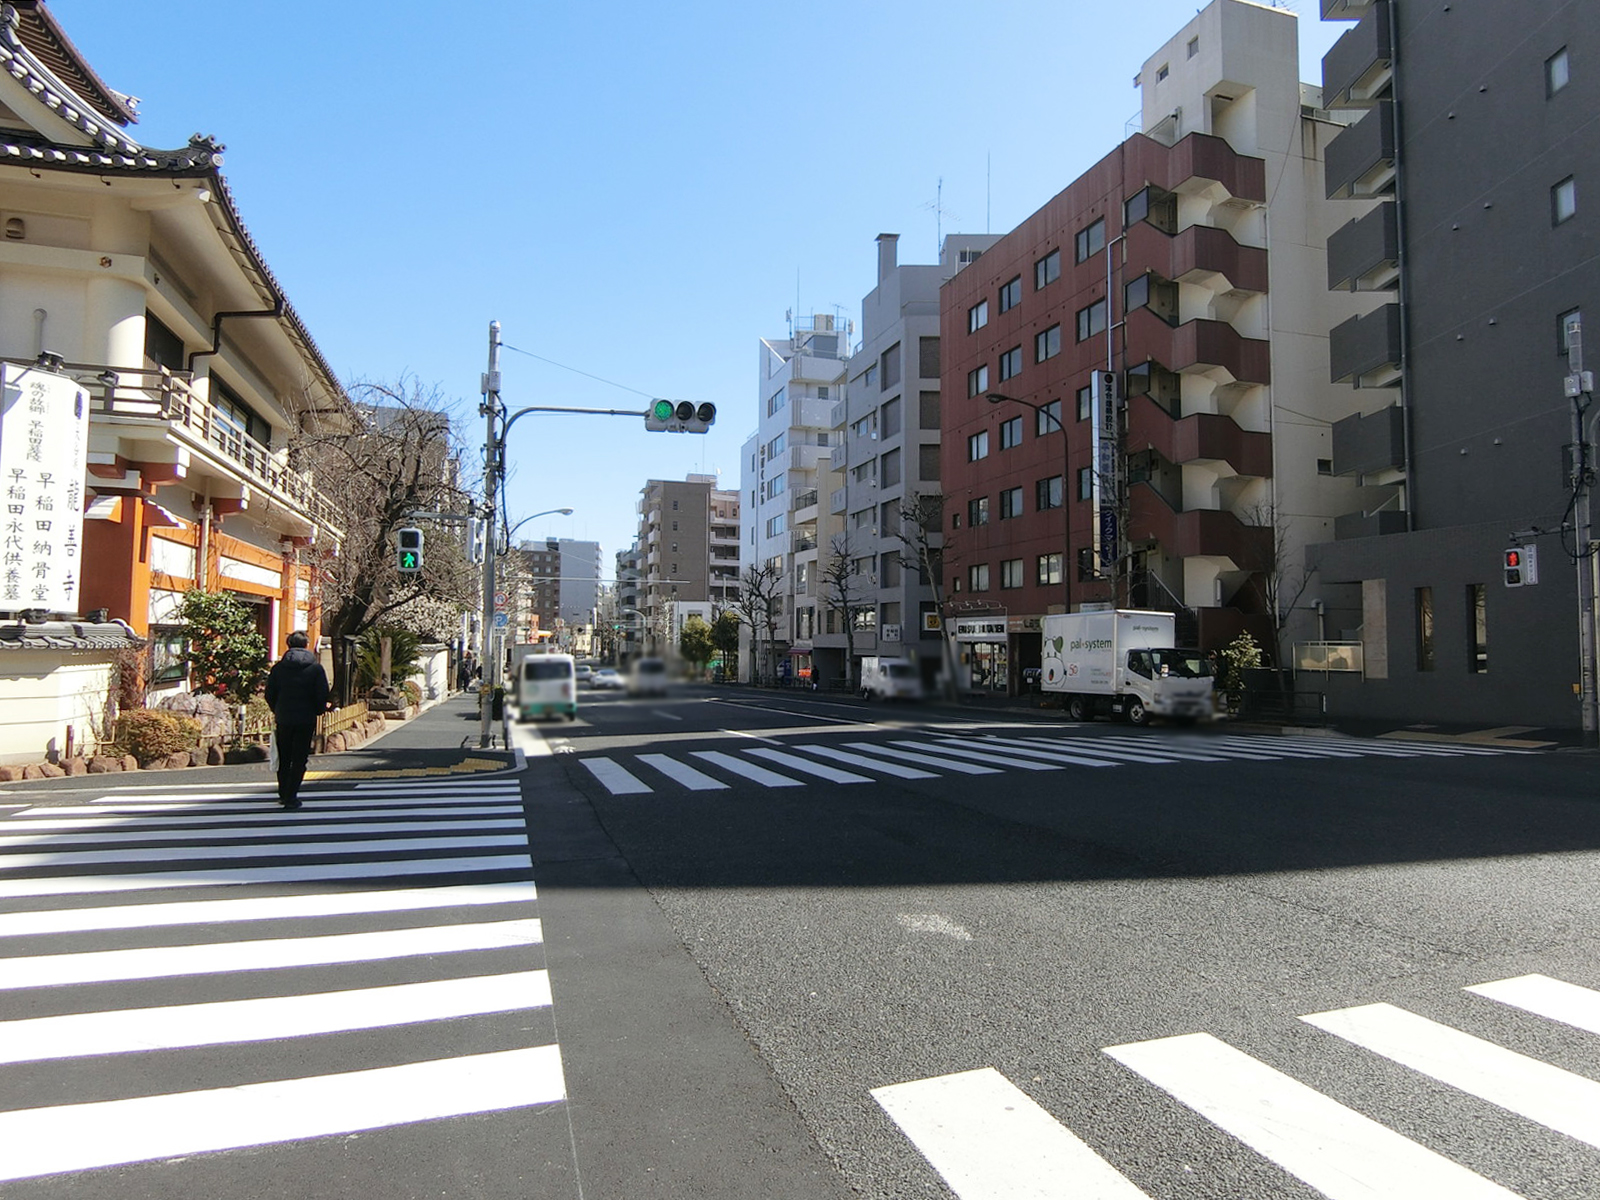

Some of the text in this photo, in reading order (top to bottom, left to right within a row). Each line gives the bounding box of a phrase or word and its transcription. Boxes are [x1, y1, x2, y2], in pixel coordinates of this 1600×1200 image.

[4, 467, 28, 601] 早稲田永代供養墓
[31, 472, 55, 601] 早稲田納骨堂
